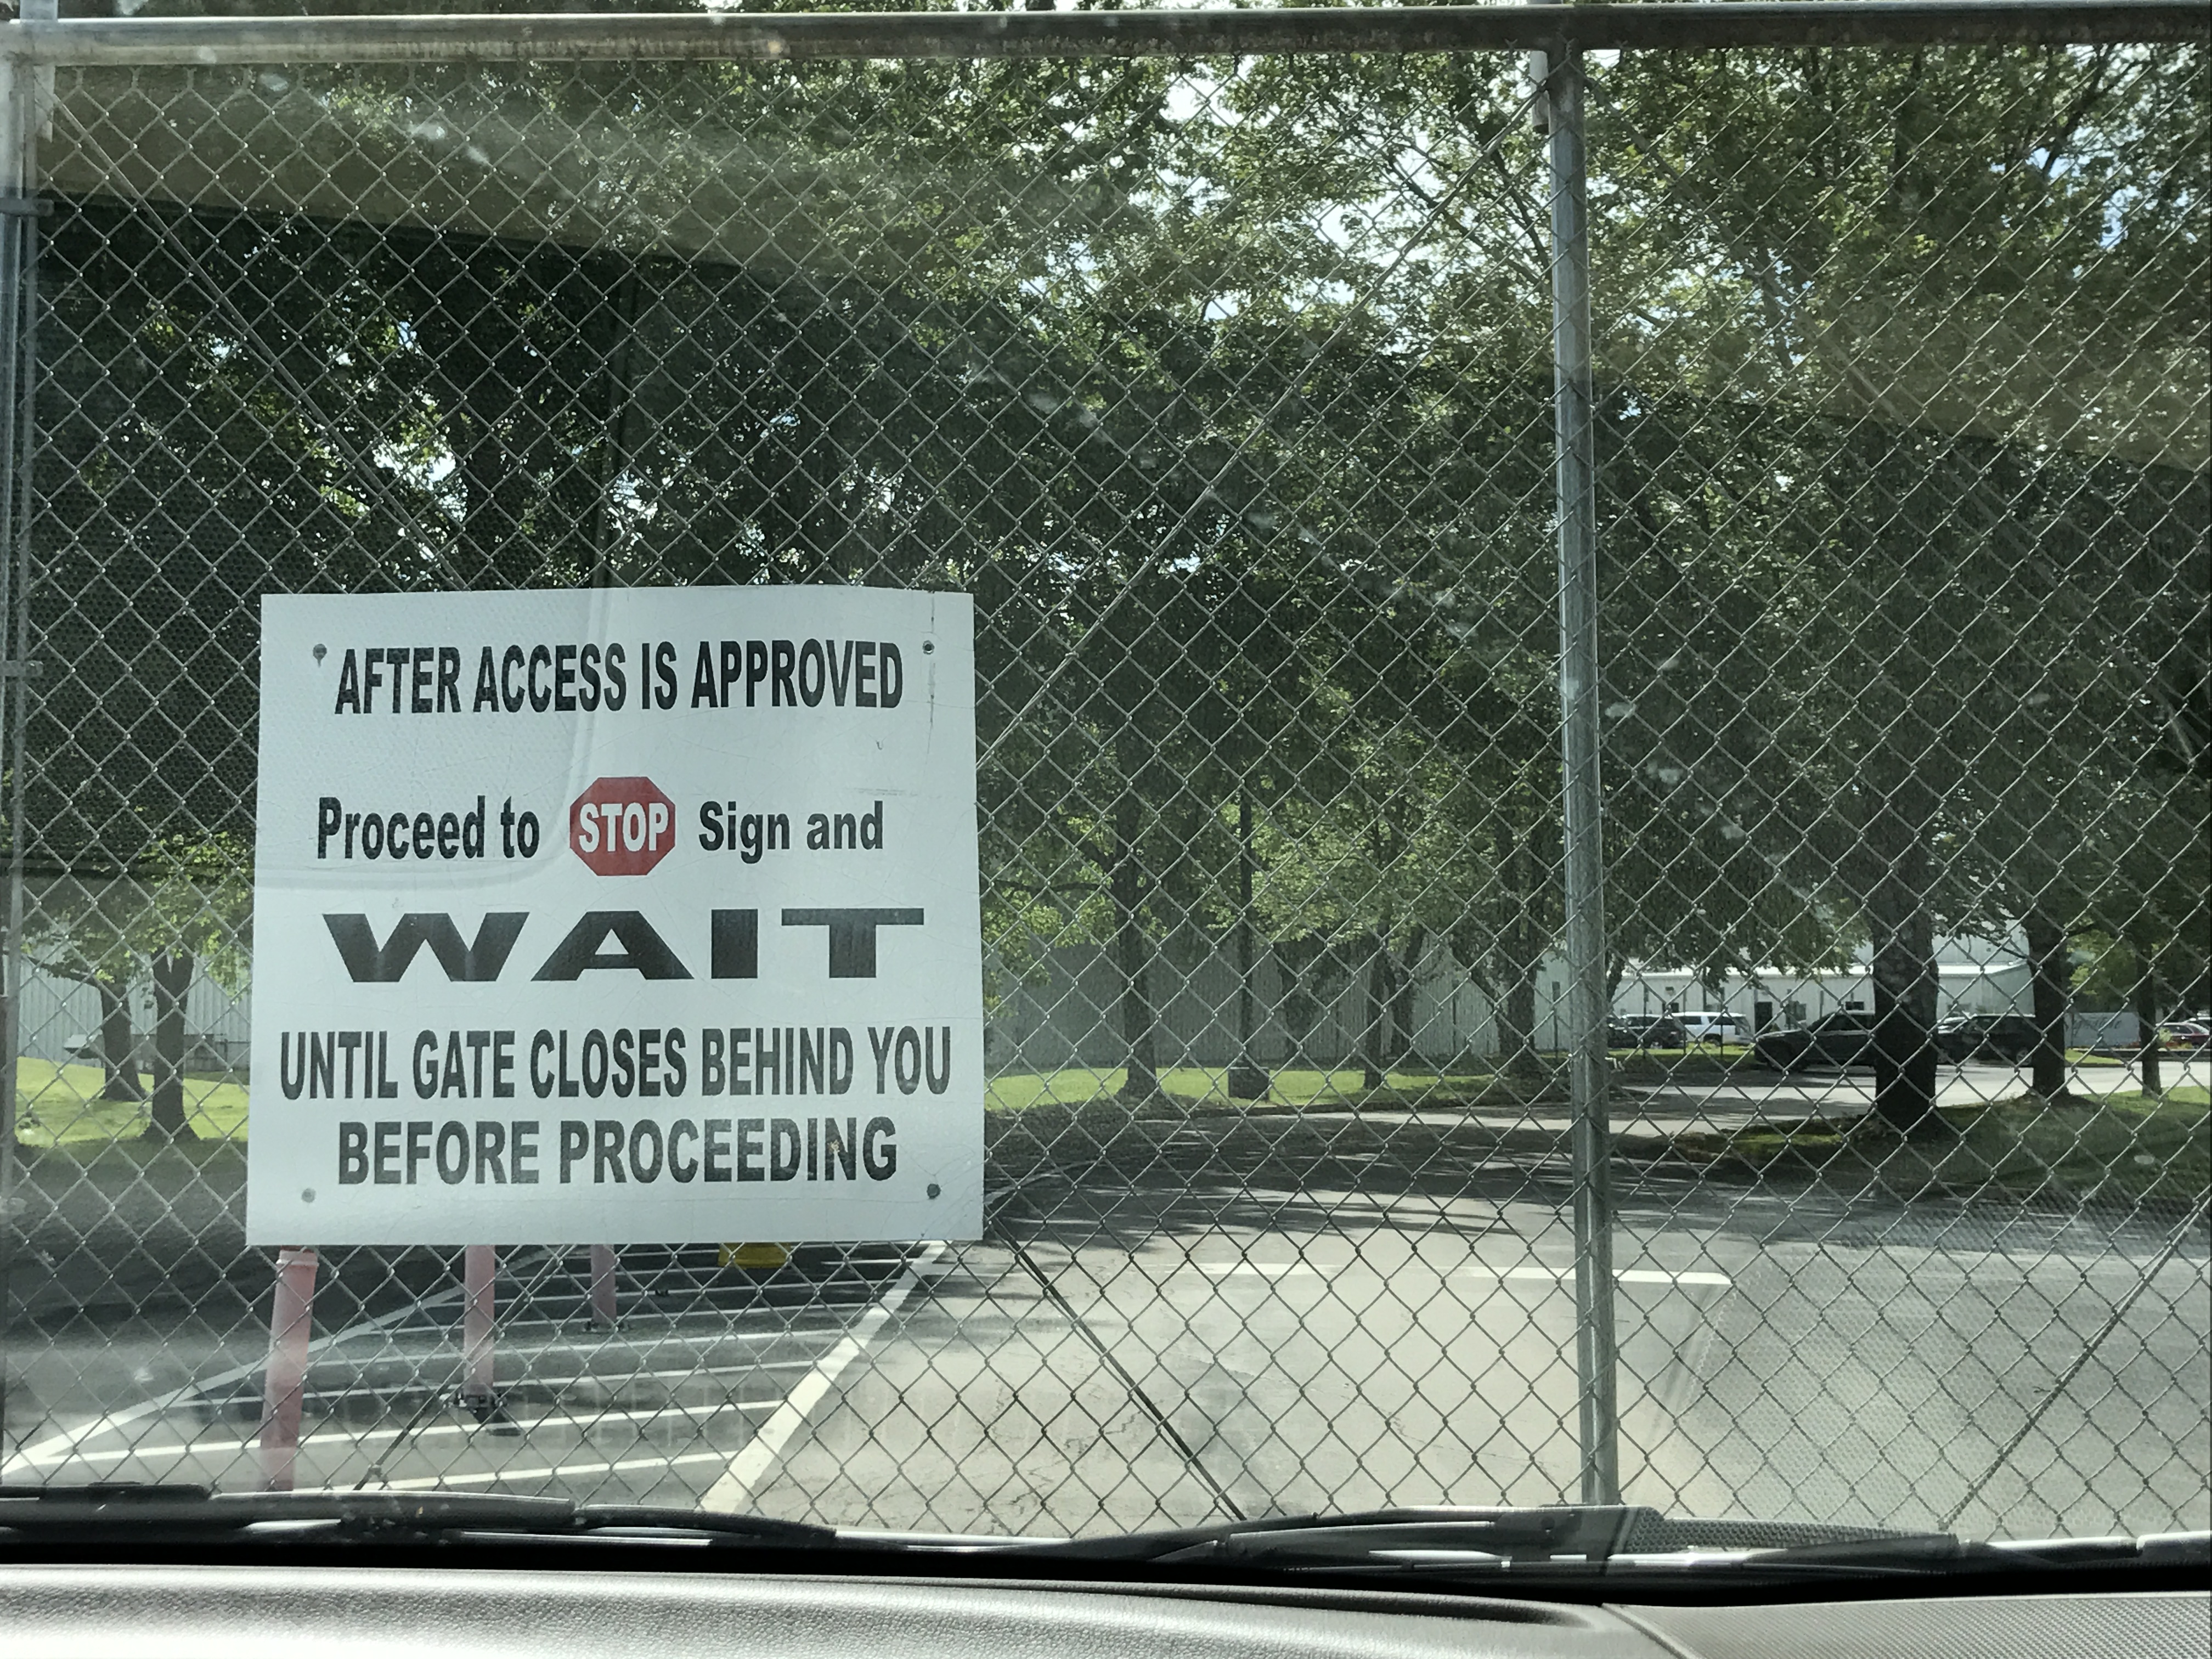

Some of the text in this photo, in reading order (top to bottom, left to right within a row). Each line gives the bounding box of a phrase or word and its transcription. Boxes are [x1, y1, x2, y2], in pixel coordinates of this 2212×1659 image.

[335, 639, 902, 714] AFTER ACCESS IS APPROVED
[318, 795, 883, 864] Proceed to STOP Sign and
[323, 909, 924, 982] WAIT
[281, 1026, 950, 1100] UNTIL GATE CLOSES BEHIND YOU
[339, 1117, 896, 1184] BEFORE PROCEEDING
